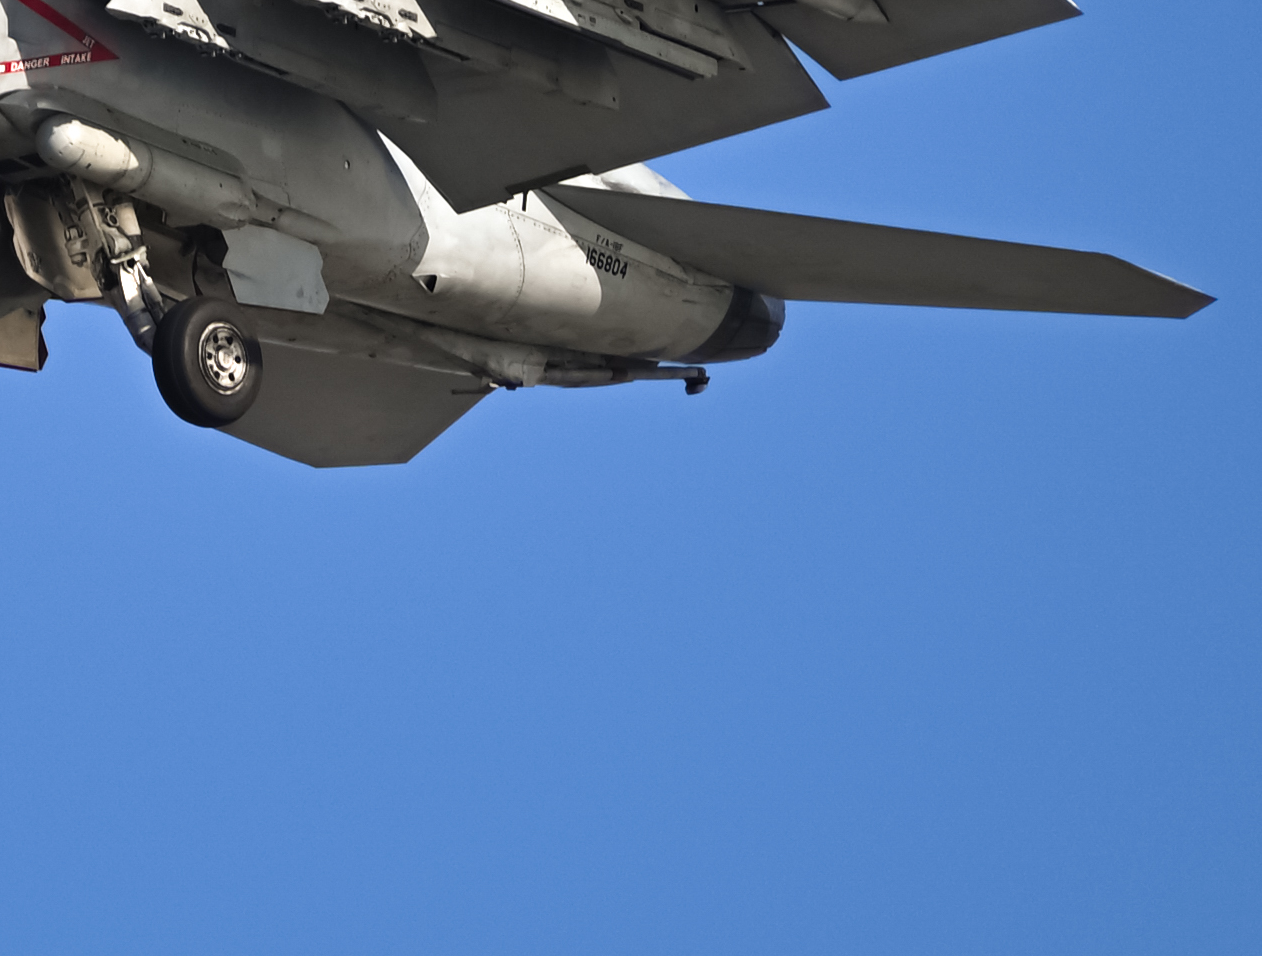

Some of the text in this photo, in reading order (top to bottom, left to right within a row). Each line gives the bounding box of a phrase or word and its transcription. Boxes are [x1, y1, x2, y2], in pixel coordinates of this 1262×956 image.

[82, 35, 96, 49] JET
[10, 51, 92, 72] DANGER INTAKE
[586, 246, 628, 280] 166804
